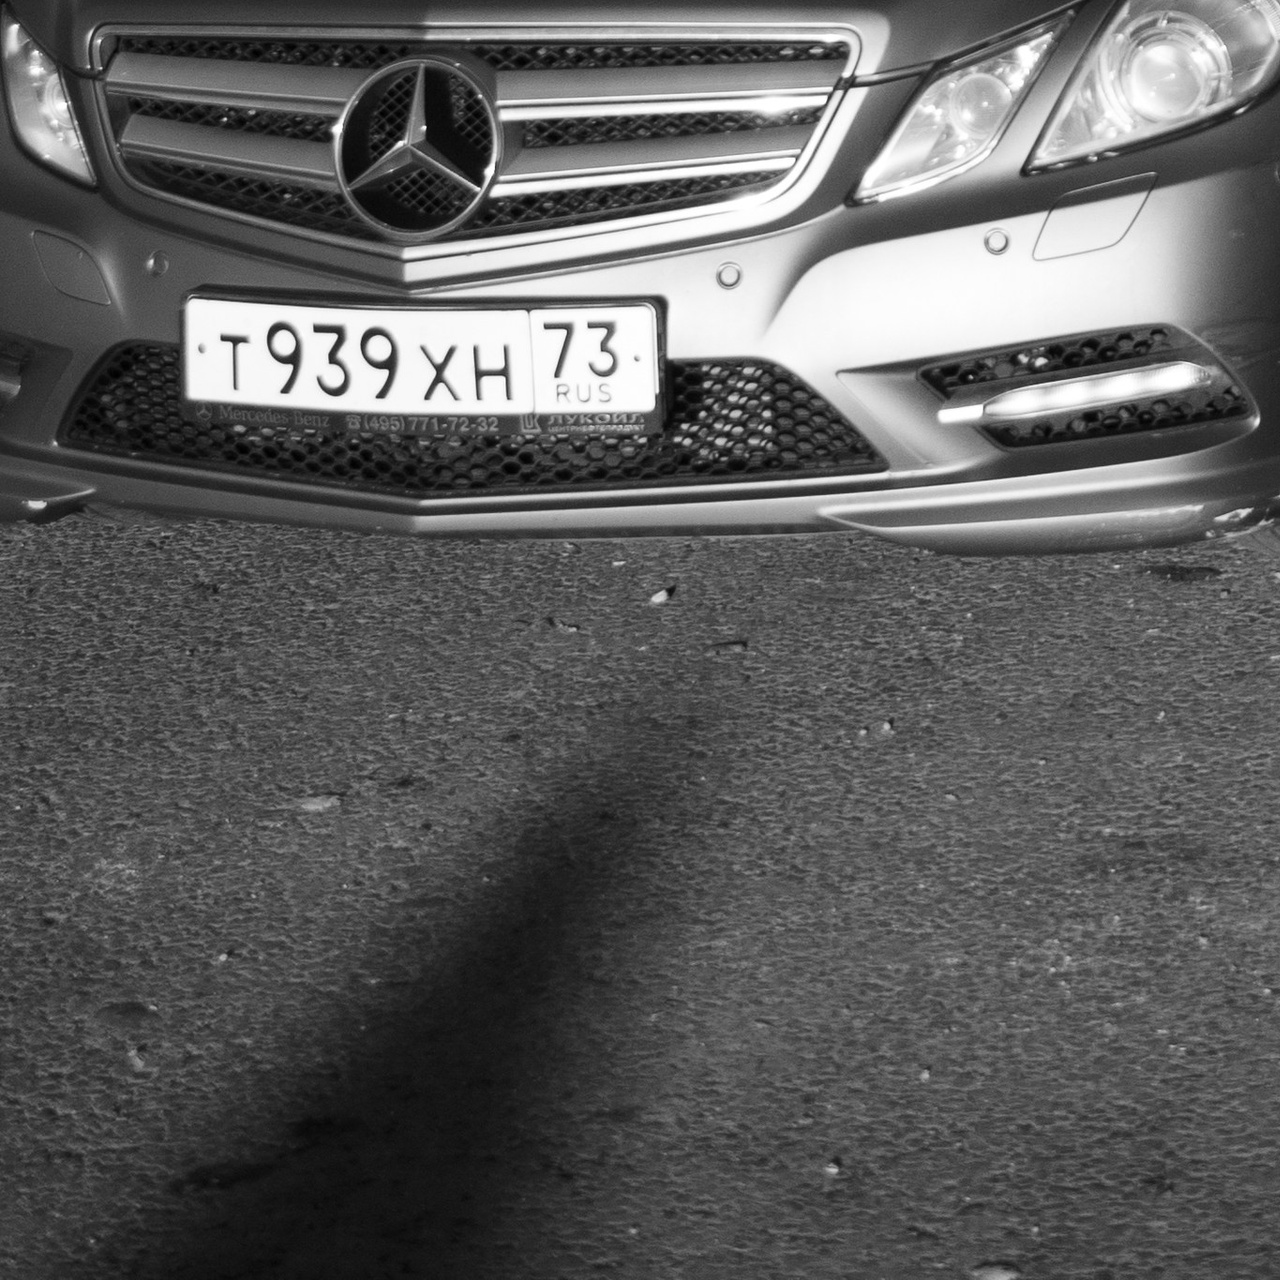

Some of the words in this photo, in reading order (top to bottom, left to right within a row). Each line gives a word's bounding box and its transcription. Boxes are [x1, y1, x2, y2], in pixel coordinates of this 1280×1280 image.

[543, 321, 619, 379] 73
[556, 383, 612, 403] RUS
[219, 404, 330, 428] Mercedes-Benz
